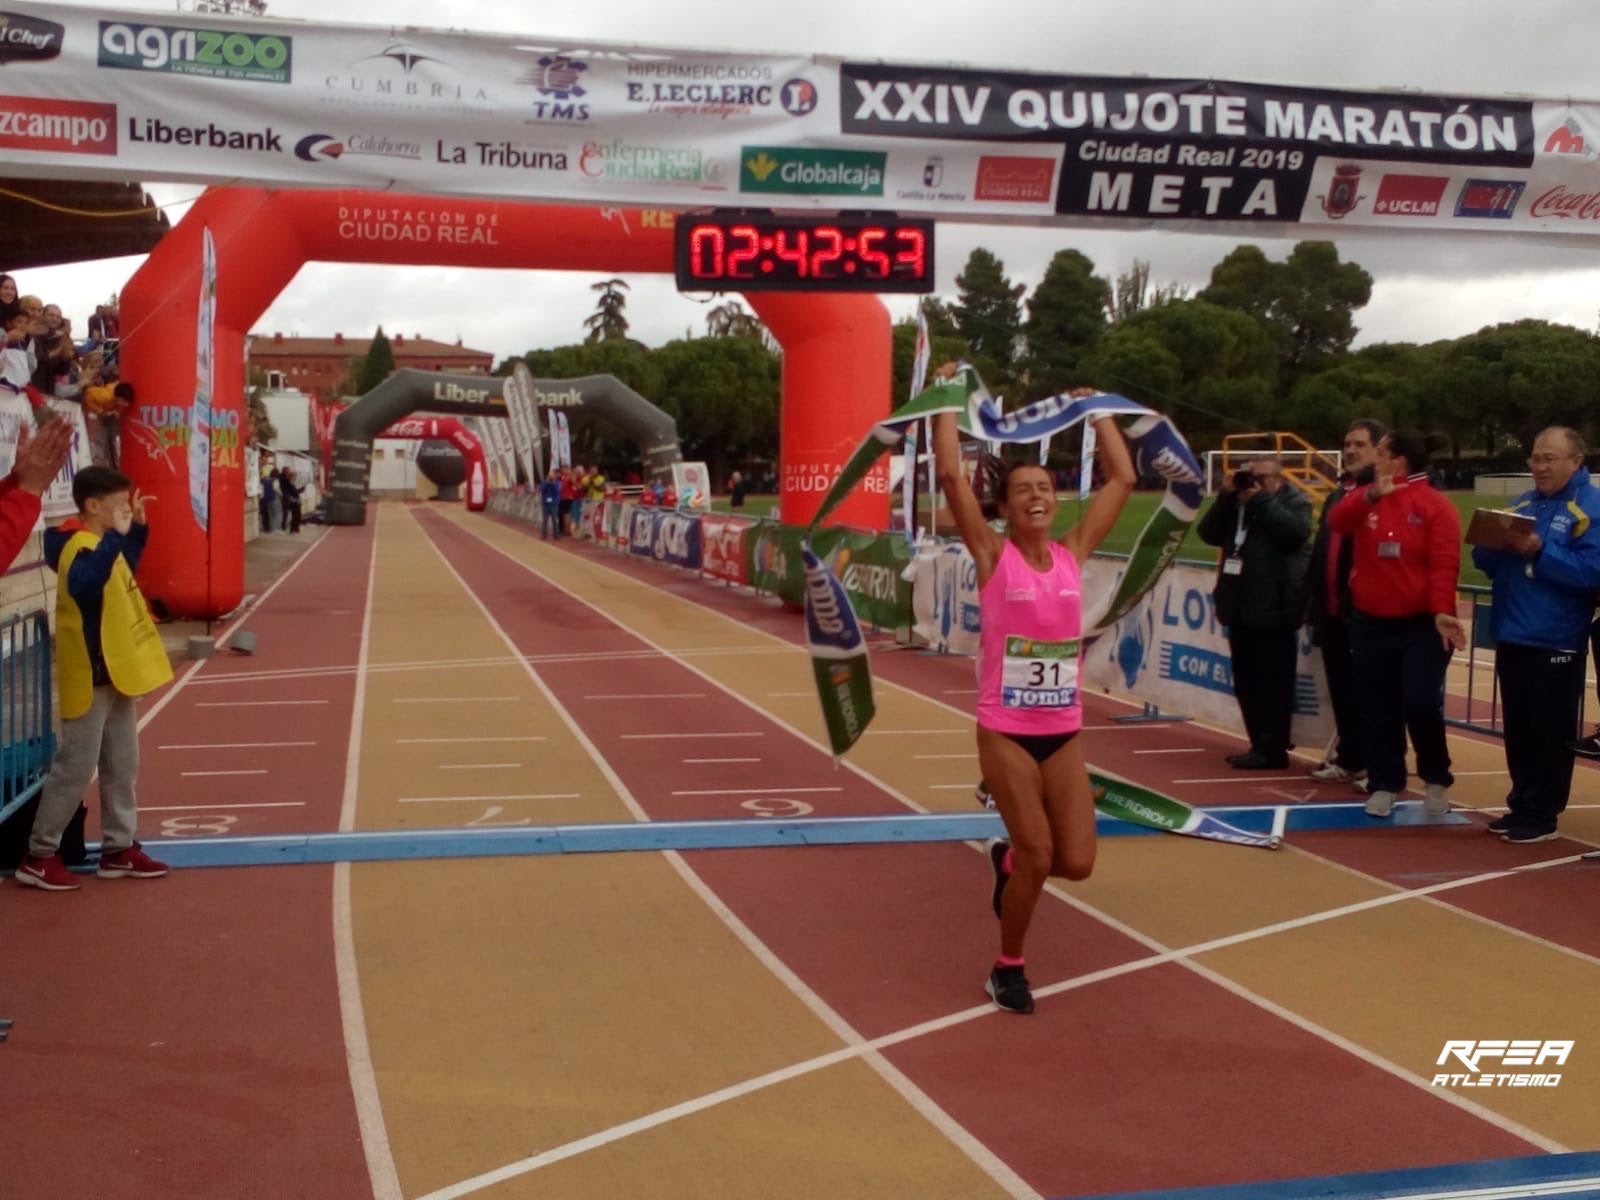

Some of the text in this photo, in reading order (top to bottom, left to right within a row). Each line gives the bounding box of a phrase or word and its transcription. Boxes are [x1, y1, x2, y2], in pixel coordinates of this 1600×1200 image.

[8, 28, 55, 50] Chef
[627, 63, 773, 81] HIPERMERCADOS
[325, 76, 488, 101] CUMBRIA
[532, 101, 591, 121] TMS
[853, 79, 1517, 152] XXIV QUIJOTE MARATÓN
[129, 117, 283, 153] Liberbank
[437, 139, 568, 171] La Tribuna
[1078, 140, 1305, 170] Ciudad Real 2019
[781, 162, 881, 192] Globalcaja
[1087, 171, 1278, 216] META
[1389, 200, 1437, 214] UCLM
[338, 220, 499, 245] CIUDAD REAL
[476, 213, 498, 226] DE
[690, 223, 925, 278] 02:42:53
[433, 382, 490, 404] Liber
[1028, 660, 1060, 688] 31
[1179, 655, 1228, 682] CON EL
